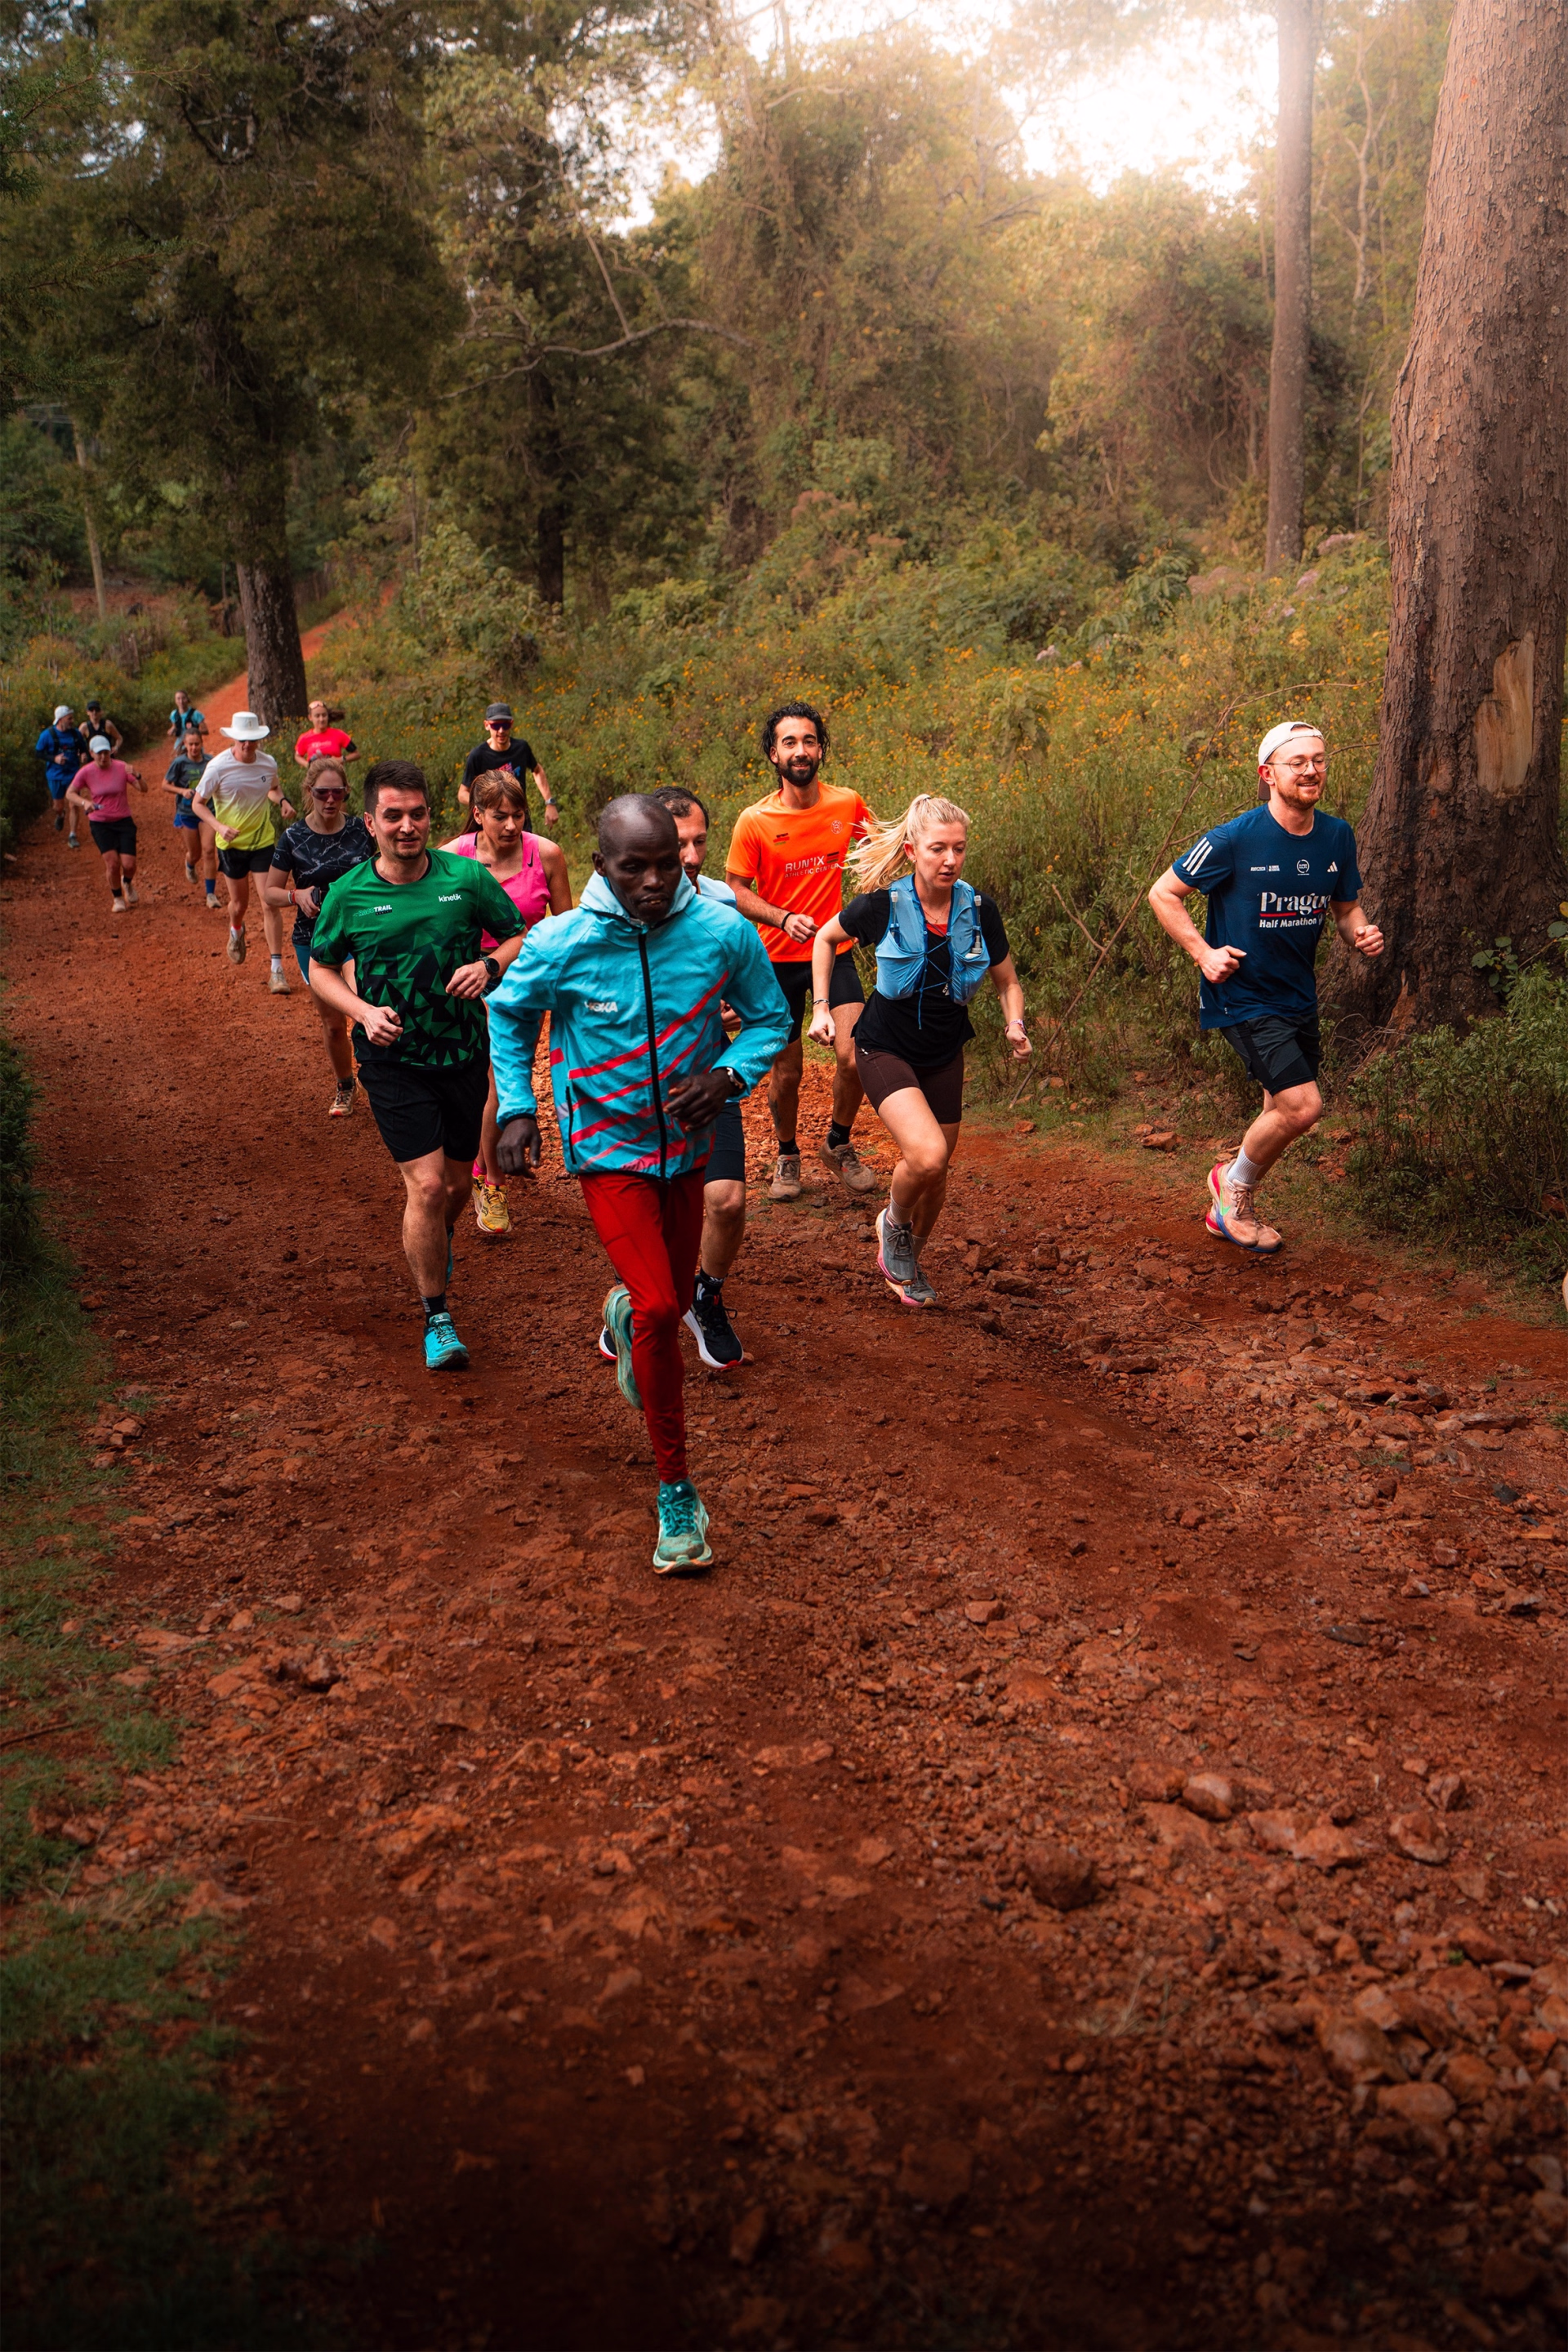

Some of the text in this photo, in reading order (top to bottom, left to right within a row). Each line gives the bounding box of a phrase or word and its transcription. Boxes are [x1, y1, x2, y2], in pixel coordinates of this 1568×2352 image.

[785, 868, 814, 879] ATHLETIC
[438, 893, 462, 902] kinetik
[1259, 917, 1316, 929] Half Marathon
